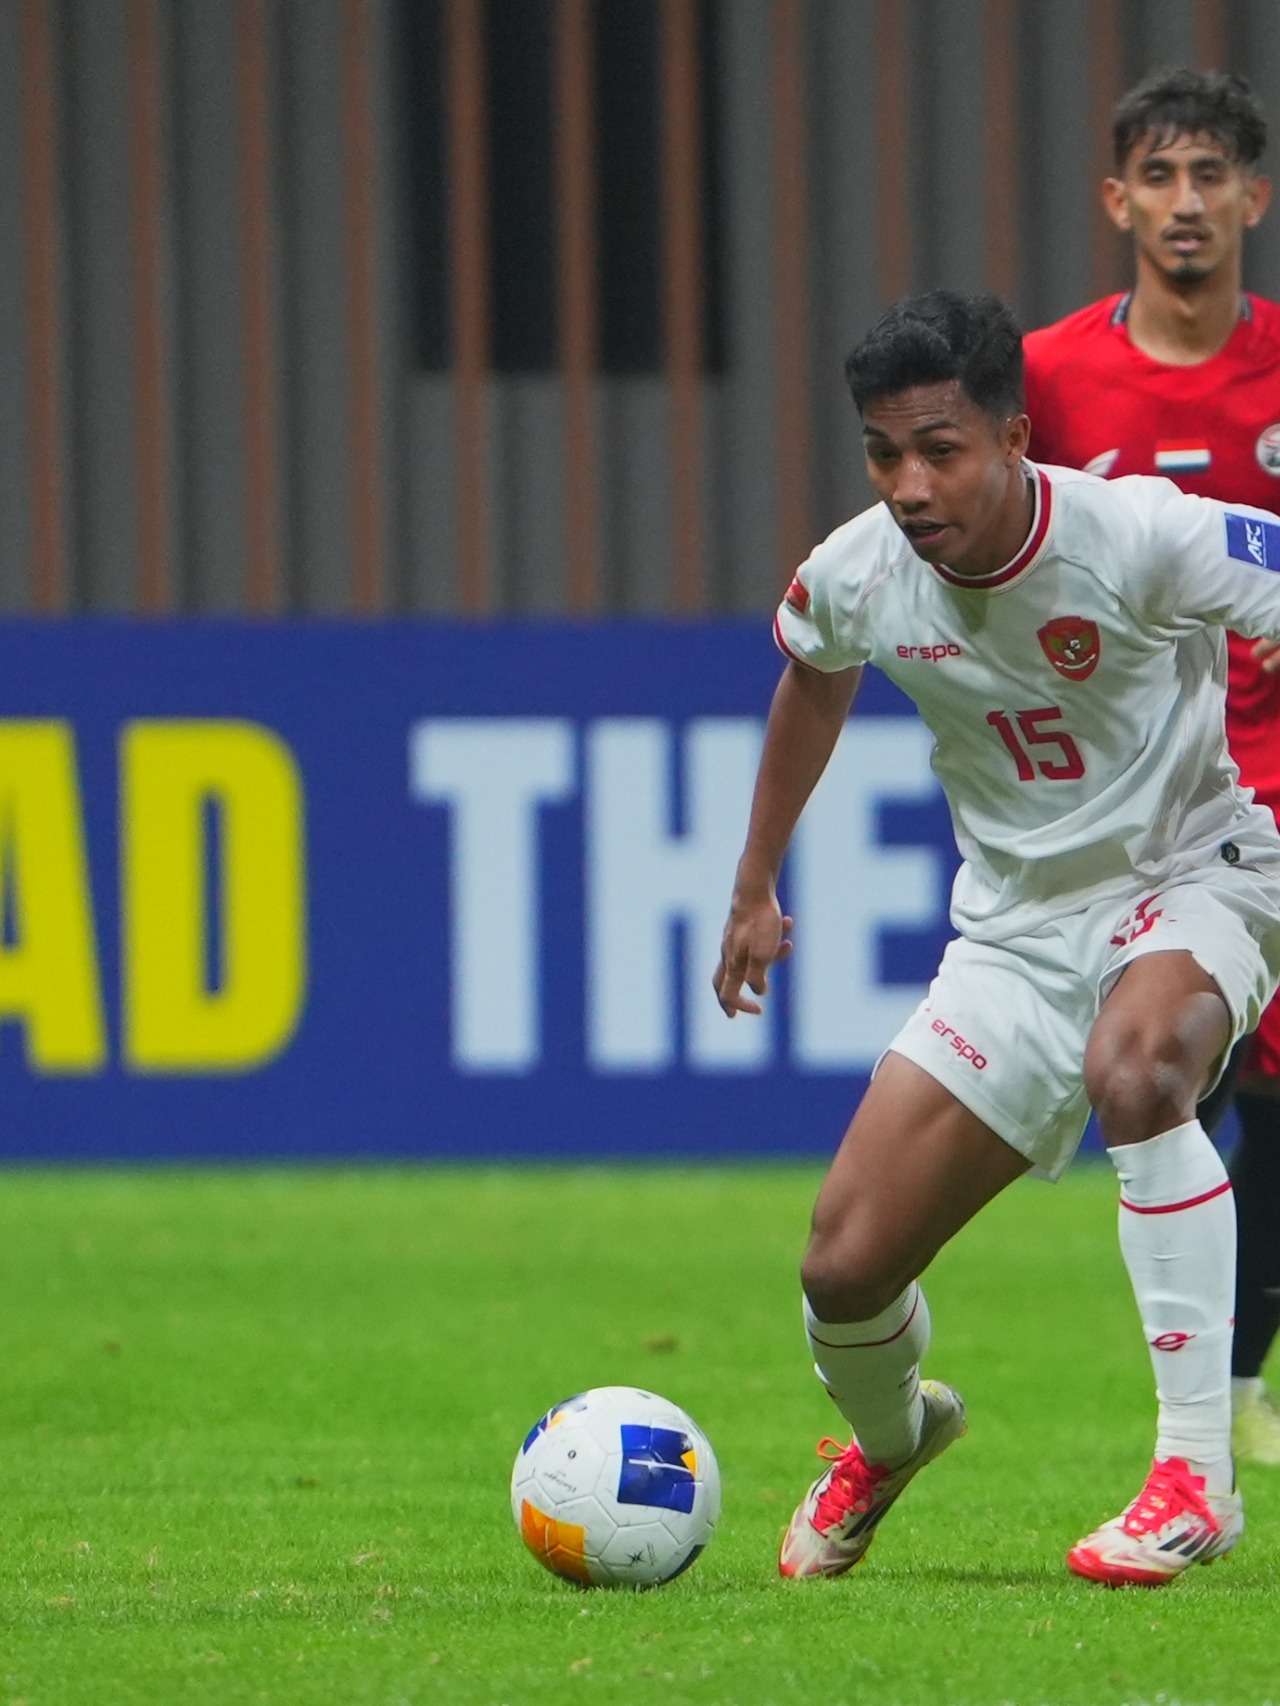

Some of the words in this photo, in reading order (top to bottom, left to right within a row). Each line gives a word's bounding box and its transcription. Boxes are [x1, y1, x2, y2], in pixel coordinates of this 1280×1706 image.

[1245, 521, 1263, 565] AFC
[896, 644, 961, 662] erspo
[986, 706, 1086, 781] 15
[410, 714, 938, 1076] THE
[931, 1018, 988, 1071] erspo
